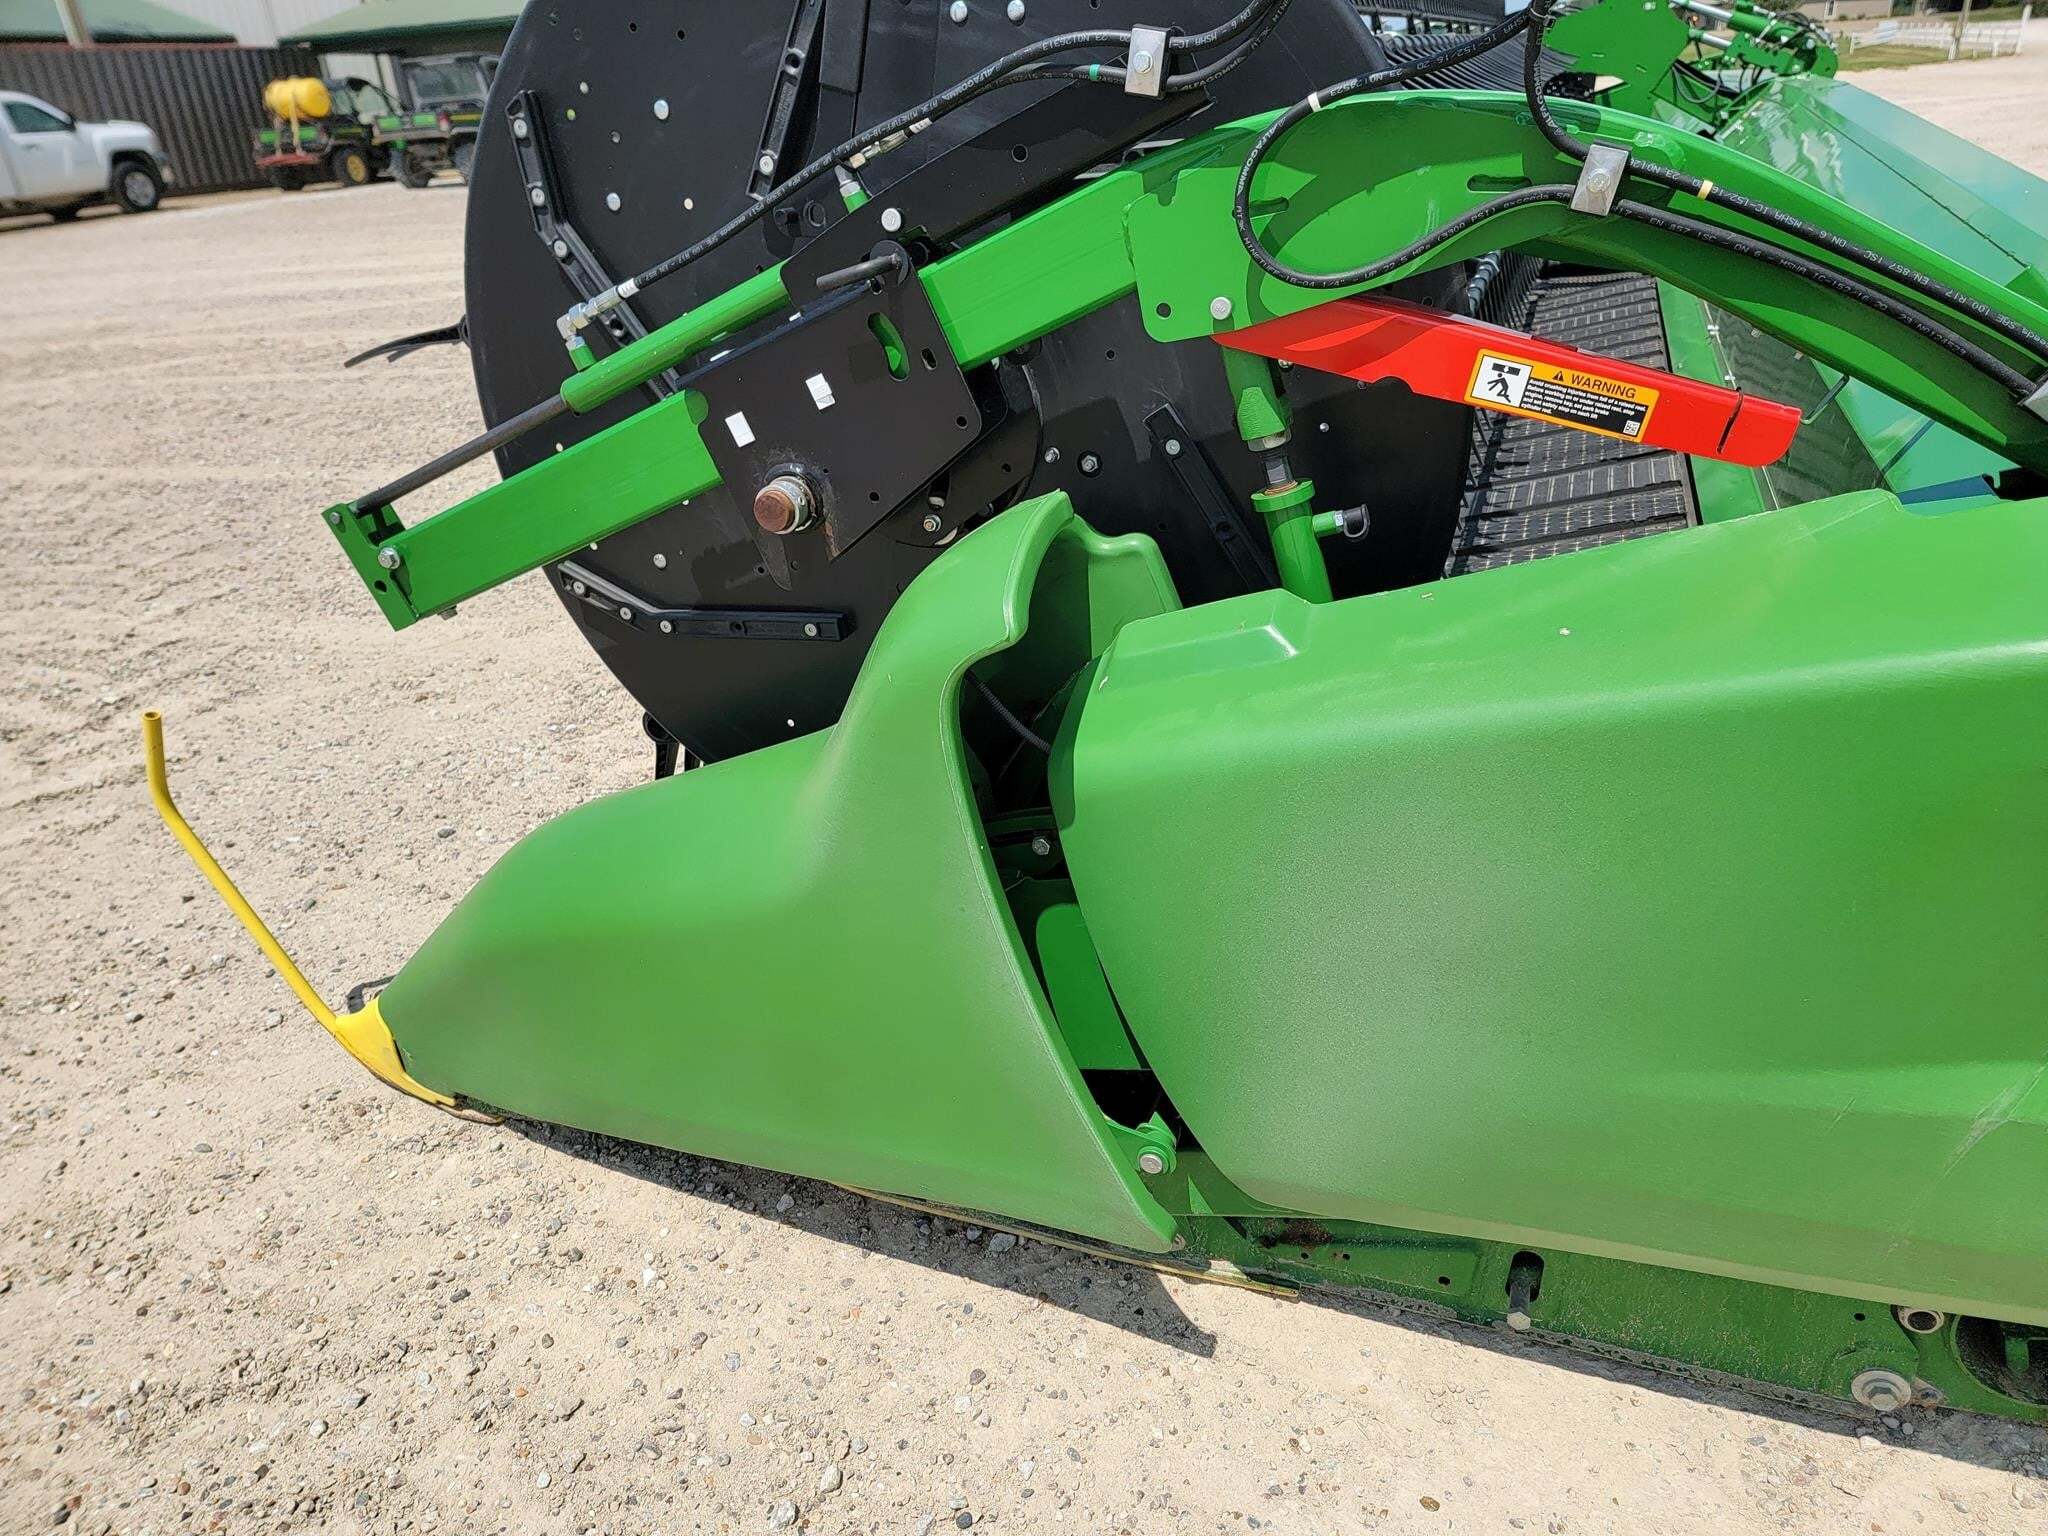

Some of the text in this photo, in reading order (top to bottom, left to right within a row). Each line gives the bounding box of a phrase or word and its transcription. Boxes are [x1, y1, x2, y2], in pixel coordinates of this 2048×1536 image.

[1095, 33, 1107, 41] 23
[939, 65, 998, 102] ALFAGOMMA
[1534, 59, 1557, 129] ALFAGOMMA
[1665, 169, 1679, 179] 23
[1237, 122, 1277, 198] ALFAGOMMA
[1437, 222, 1466, 242] (3300
[1470, 206, 1496, 224] PSI)
[1502, 193, 1550, 208] exceeds
[1754, 250, 1761, 258] 6
[1711, 183, 1768, 215] IC-152/16
[1773, 210, 1800, 228] MSHA
[1819, 230, 1827, 238] 6
[1831, 234, 1846, 247] DN
[1888, 261, 1909, 276] 857
[1945, 287, 1966, 303] R17
[1971, 301, 1989, 315] 100
[1571, 374, 1636, 398] WARNING
[1544, 389, 1565, 399] working
[1544, 383, 1567, 393] crushing
[1567, 388, 1586, 397] injuries
[1619, 401, 1635, 409] raised
[1521, 403, 1541, 412] cylinder
[1542, 401, 1558, 409] safety
[1544, 396, 1563, 404] remove
[1595, 408, 1609, 416] brake
